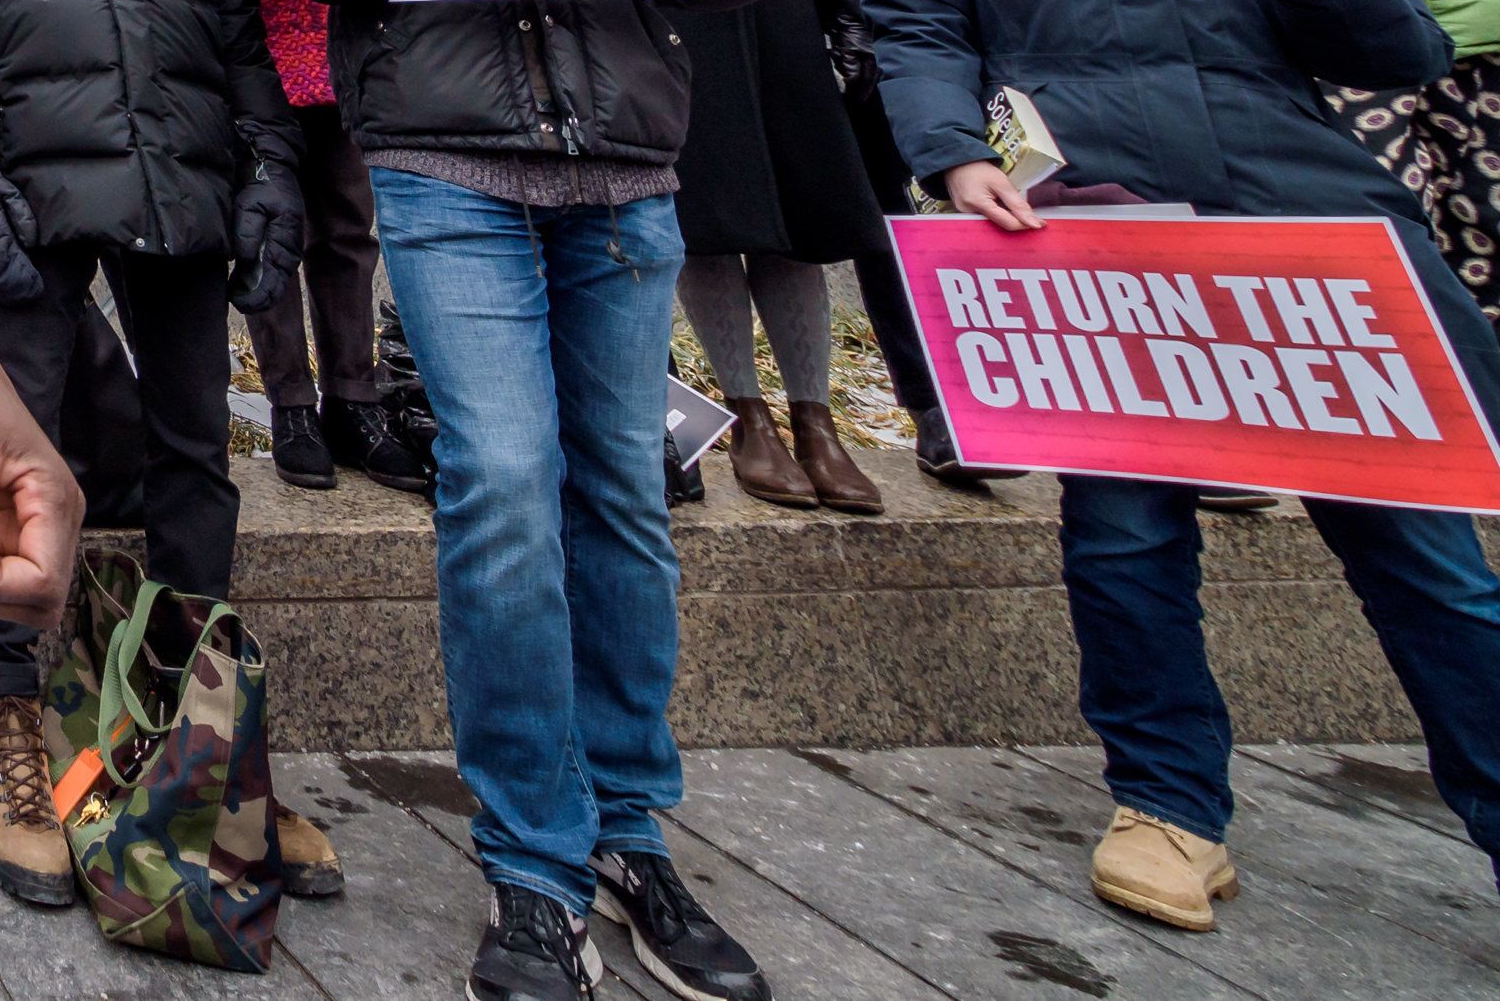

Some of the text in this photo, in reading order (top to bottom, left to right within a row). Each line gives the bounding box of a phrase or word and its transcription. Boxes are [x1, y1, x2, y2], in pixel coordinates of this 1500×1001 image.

[935, 268, 1398, 350] RETURN THE
[955, 331, 1444, 442] CHILDREN
